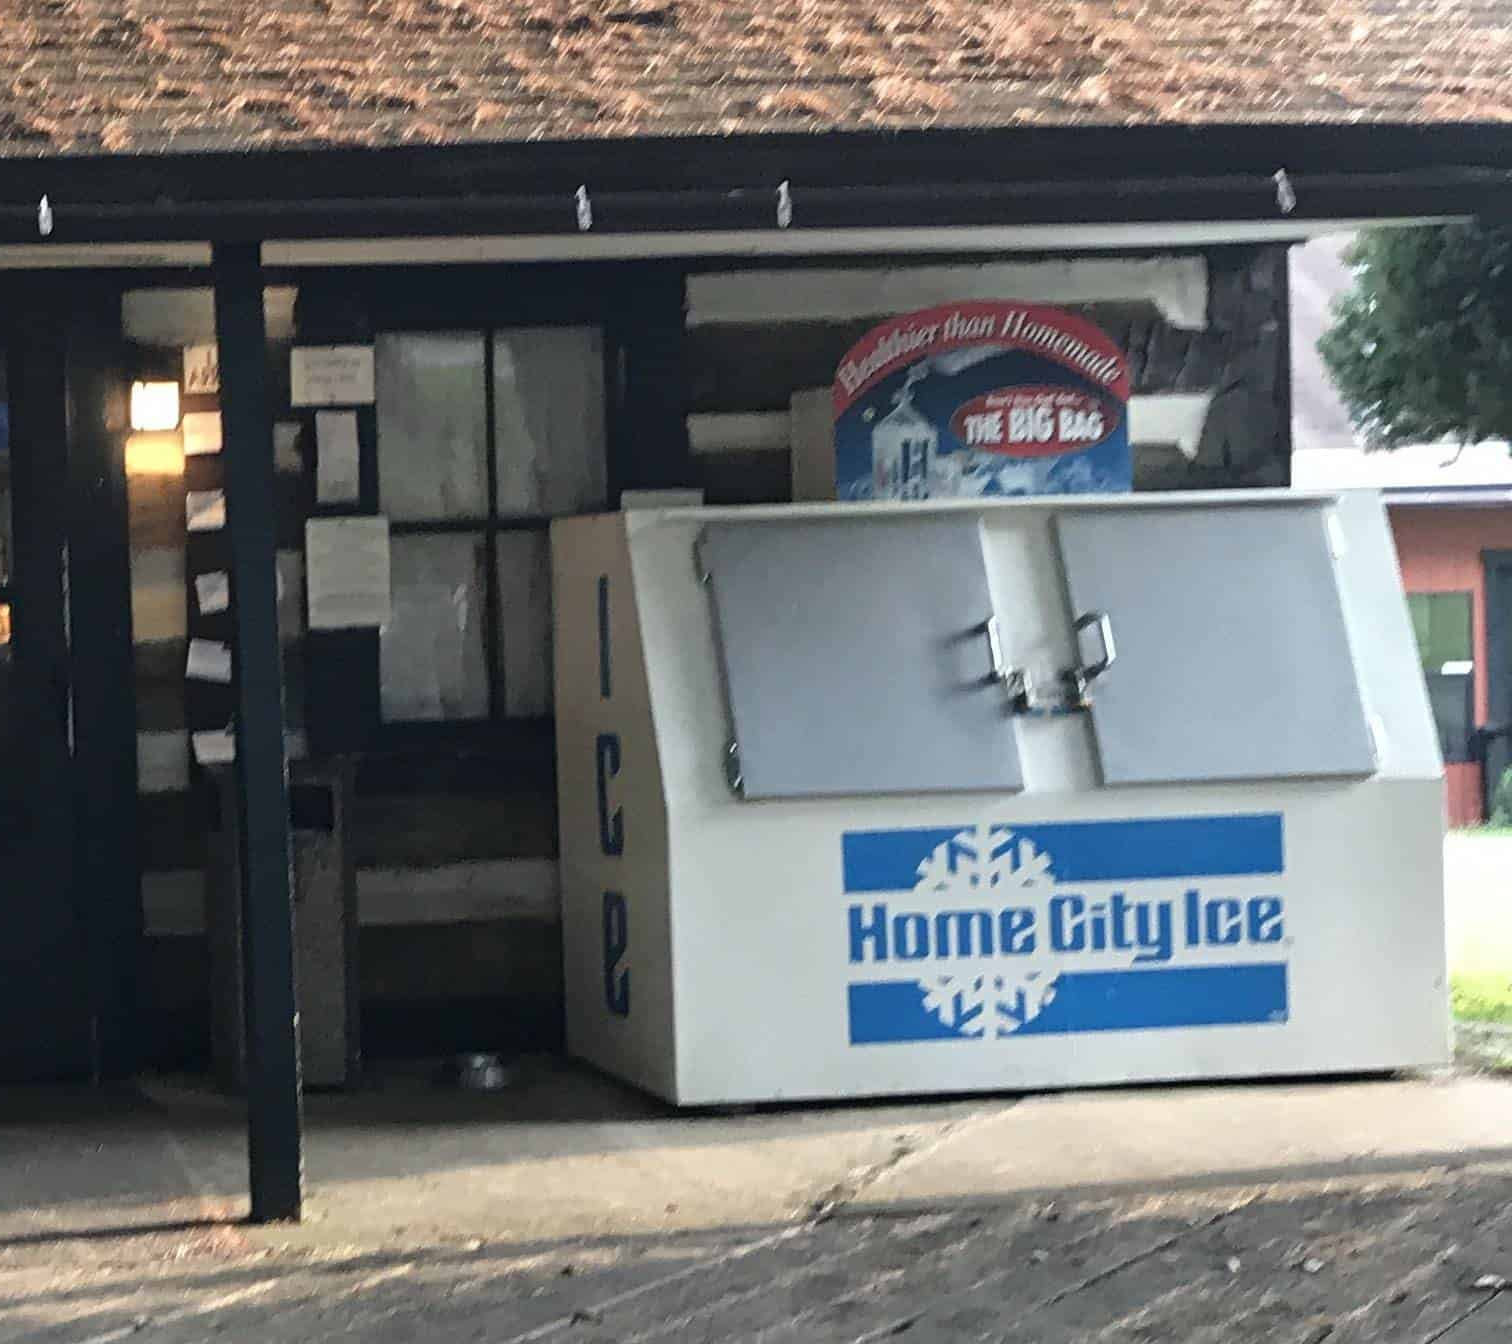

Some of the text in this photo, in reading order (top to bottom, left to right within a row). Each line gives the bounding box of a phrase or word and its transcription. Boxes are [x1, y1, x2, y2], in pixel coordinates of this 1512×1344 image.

[943, 310, 996, 341] than
[1000, 310, 1122, 387] Homemade
[963, 407, 1105, 445] THE BIG BAG
[848, 888, 1285, 967] Home City Ice
